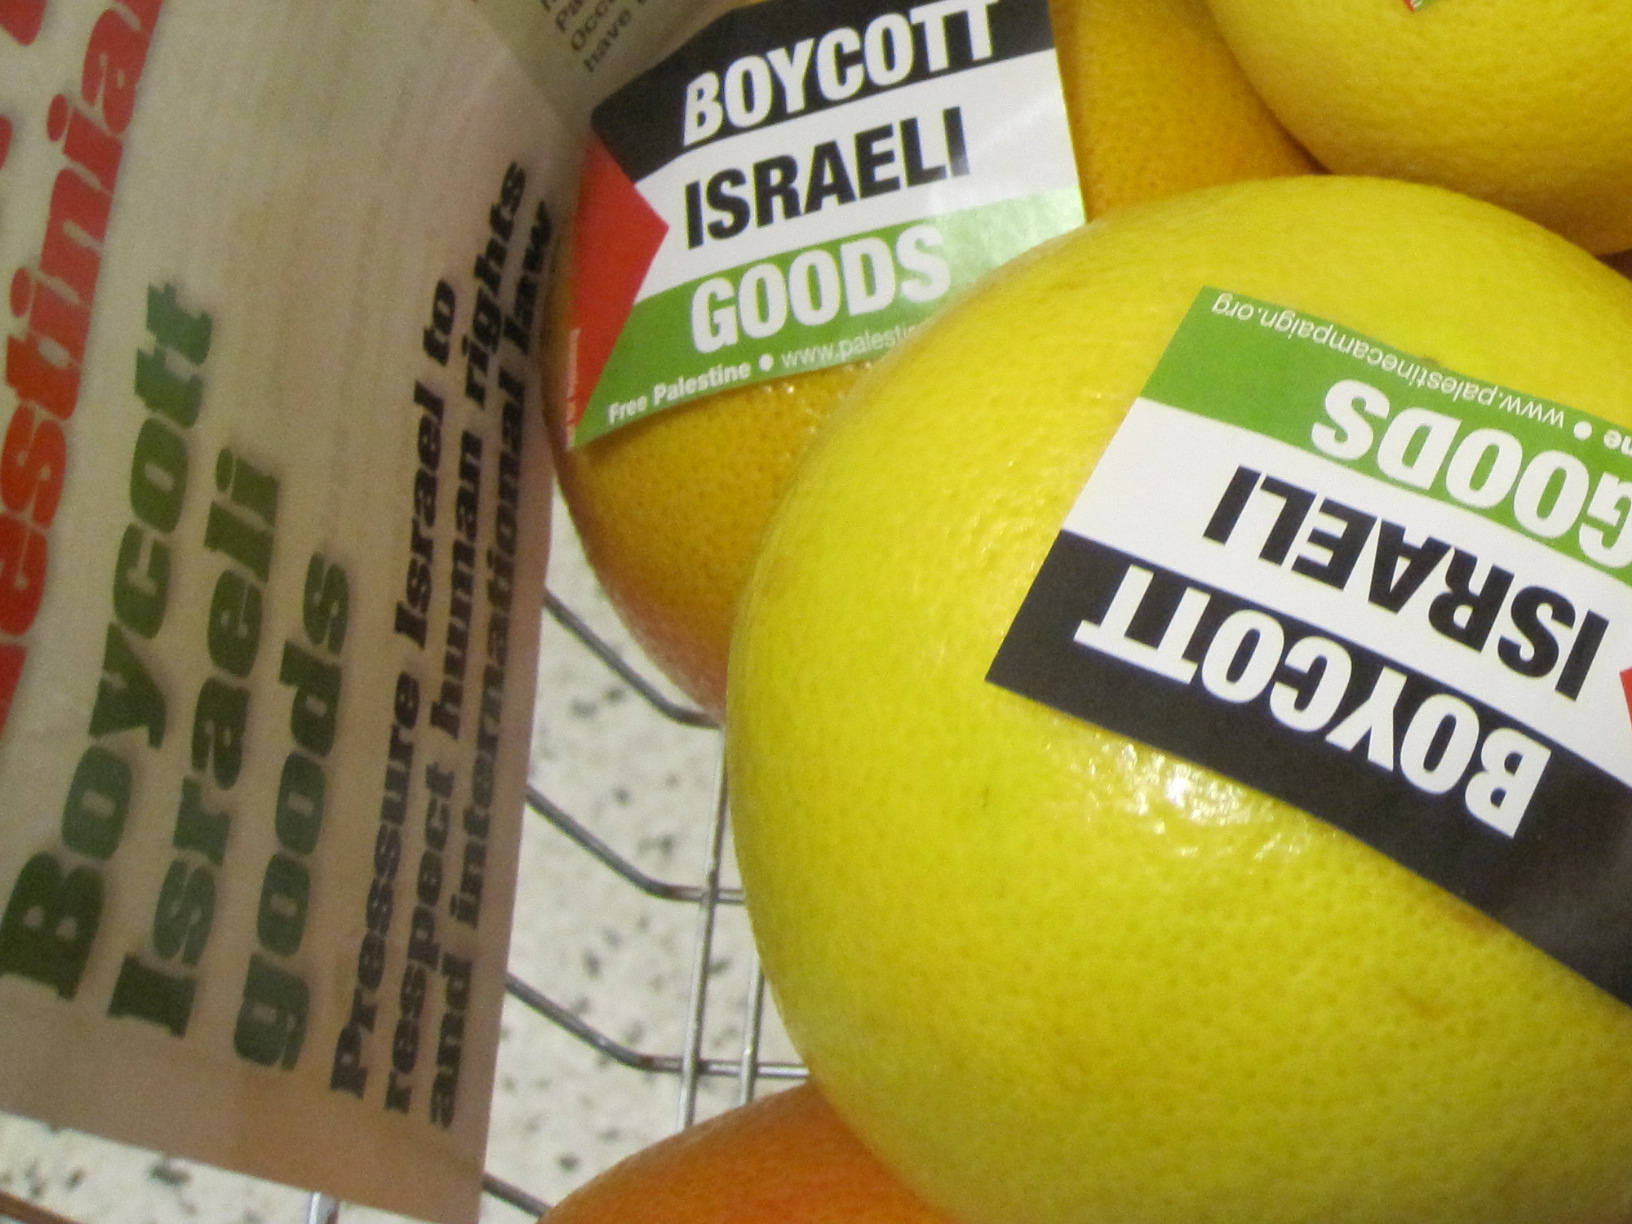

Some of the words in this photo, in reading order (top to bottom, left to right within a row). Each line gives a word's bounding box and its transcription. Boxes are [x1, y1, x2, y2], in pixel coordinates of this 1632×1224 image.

[583, 10, 633, 73] have
[503, 197, 554, 357] law
[683, 105, 971, 249] ISRAELI
[690, 225, 952, 355] GOODS
[608, 395, 647, 425] Free
[653, 361, 751, 406] Palestine
[1211, 292, 1567, 429] www.palestinecampaign.org
[0, 283, 213, 1003] Boycott
[330, 670, 420, 1101] Pressure
[394, 380, 445, 651] Israel
[423, 279, 457, 367] to
[384, 760, 455, 1115] respect
[430, 431, 483, 740] human
[460, 161, 527, 411] rights
[450, 367, 526, 931] international
[1073, 566, 1552, 839] BOYCOTT
[1202, 465, 1610, 703] ISRAELI
[107, 447, 279, 1039] Israeli
[234, 551, 350, 1072] goods
[430, 953, 474, 1129] and
